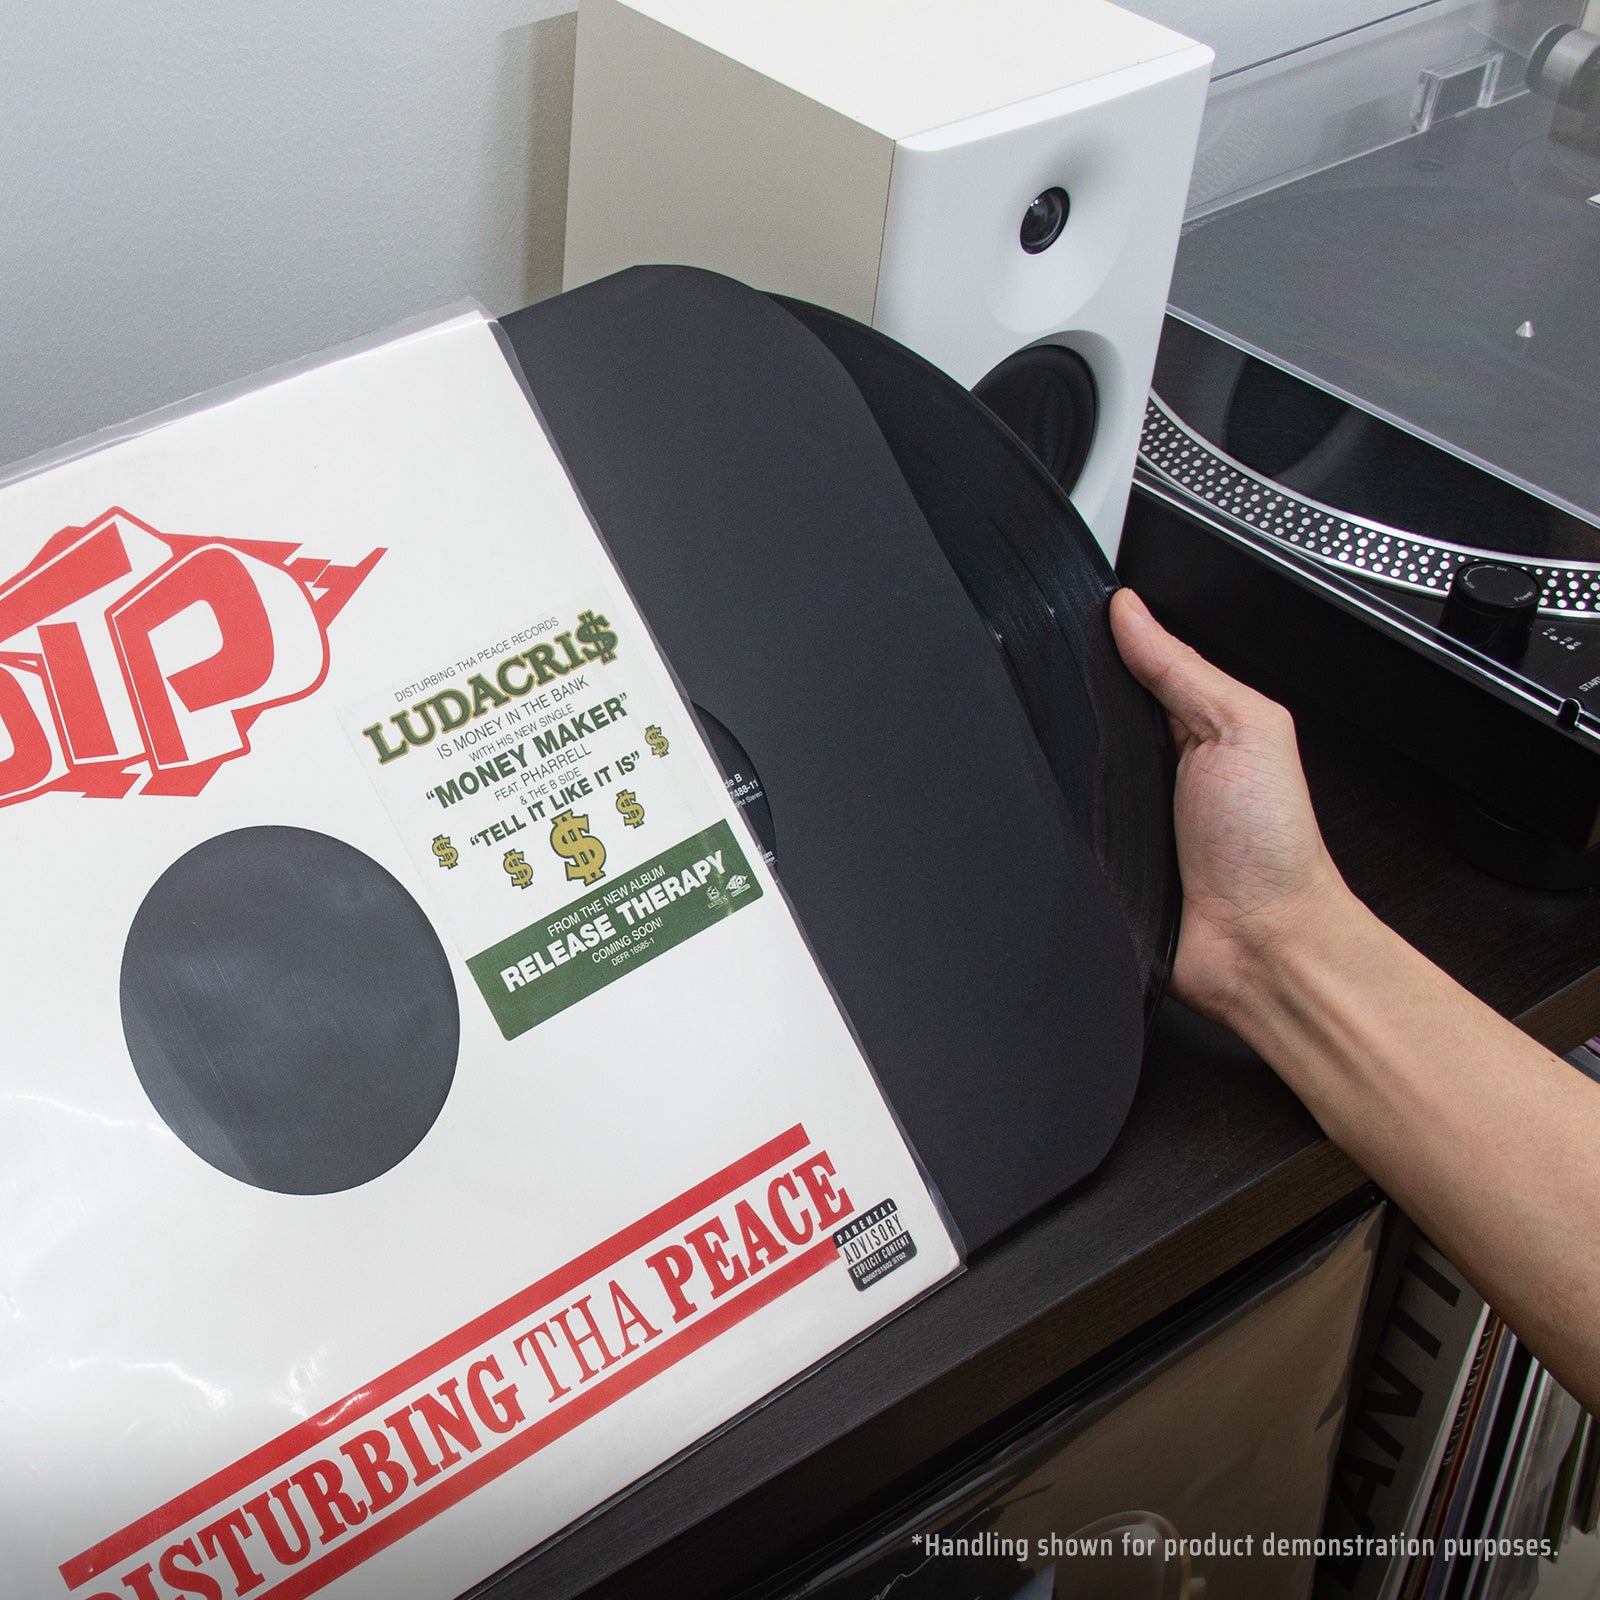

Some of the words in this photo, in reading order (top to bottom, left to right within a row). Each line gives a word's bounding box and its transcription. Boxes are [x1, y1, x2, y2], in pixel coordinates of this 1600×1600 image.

[394, 666, 456, 703] DISTURBING
[455, 657, 477, 676] THA
[477, 641, 511, 665] PEACE
[512, 616, 560, 648] RECORDS
[437, 742, 453, 759] IS
[453, 715, 503, 748] MONEY
[504, 708, 521, 726] IN
[521, 694, 549, 716] THE
[550, 675, 590, 703] BANK
[469, 744, 497, 763] WITH
[497, 734, 515, 749] HIS
[514, 721, 539, 741] NEW
[540, 703, 575, 728] SINGLE
[494, 780, 522, 802] FEAT.
[521, 743, 592, 787] PHARRELL
[519, 795, 528, 806] &
[527, 782, 549, 801] THE
[549, 778, 557, 790] B
[557, 766, 583, 786] SIDE
[527, 800, 546, 822] IT
[549, 777, 594, 811] LIKE
[594, 765, 613, 787] IT
[734, 773, 742, 784] B
[745, 790, 763, 804] Stereo
[500, 913, 618, 993] RELEASE
[615, 850, 727, 926] THERAPY
[547, 910, 581, 938] FROM
[580, 899, 603, 921] THE
[602, 882, 632, 910] NEW
[630, 865, 666, 896] ALBUM
[591, 936, 632, 964] COMING
[631, 917, 664, 944] SOON!
[611, 950, 632, 967] DEFR
[630, 938, 655, 957] 16585-1
[837, 1202, 894, 1244] PARENTAL
[843, 1213, 903, 1266] ADVISORY
[852, 1253, 882, 1278] EXPLICIT
[881, 1234, 910, 1259] CONTENT
[84, 1352, 526, 1600] STURBING
[513, 1280, 663, 1403] THA
[645, 1150, 855, 1324] PEACE
